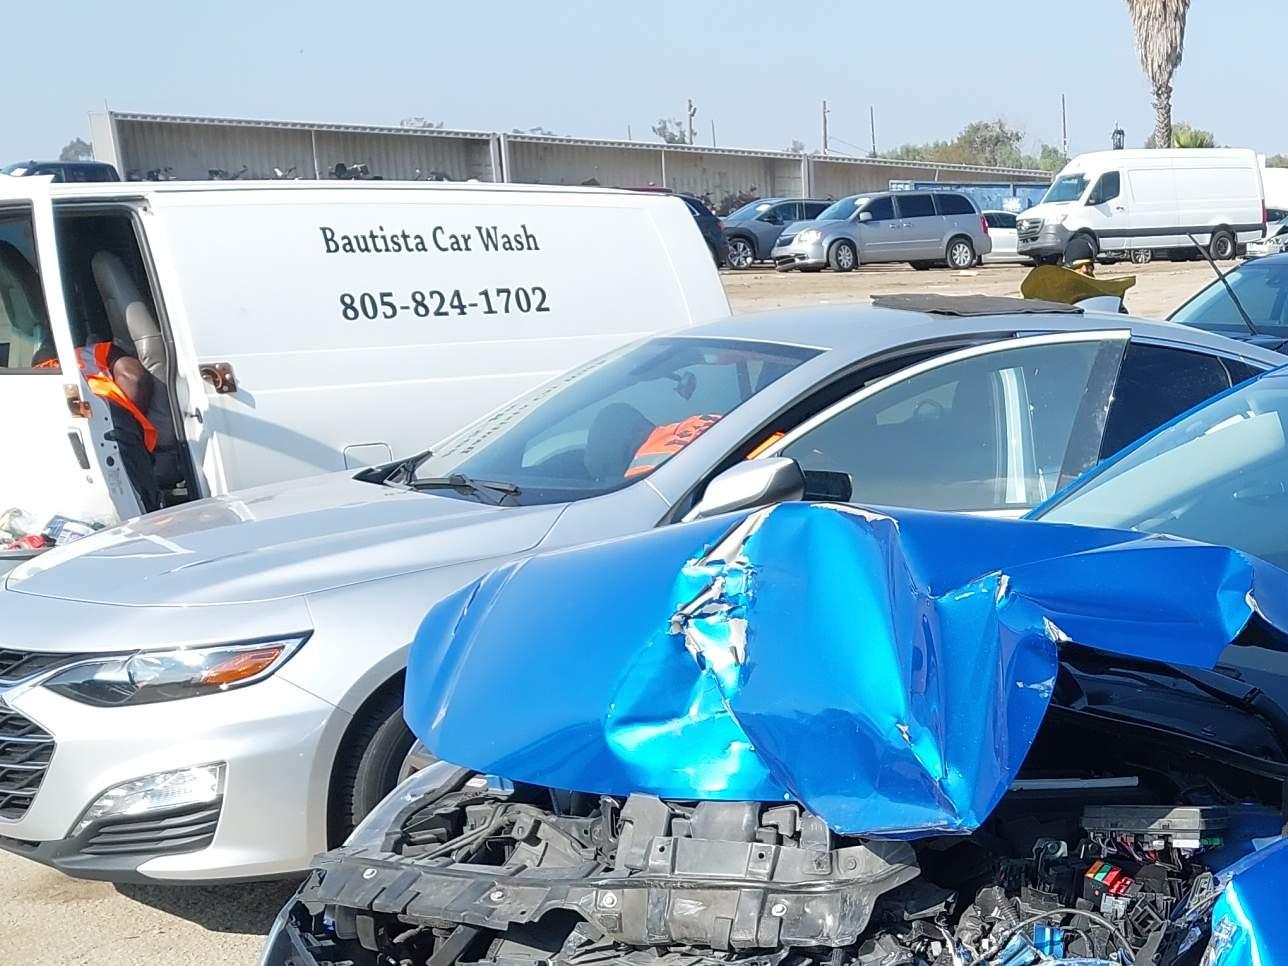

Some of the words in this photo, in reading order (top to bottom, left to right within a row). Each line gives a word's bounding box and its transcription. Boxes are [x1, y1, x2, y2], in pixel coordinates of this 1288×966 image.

[319, 225, 428, 253] Bautista
[432, 226, 472, 251] Car
[475, 224, 540, 251] Wash
[340, 286, 551, 320] 805-824-1702
